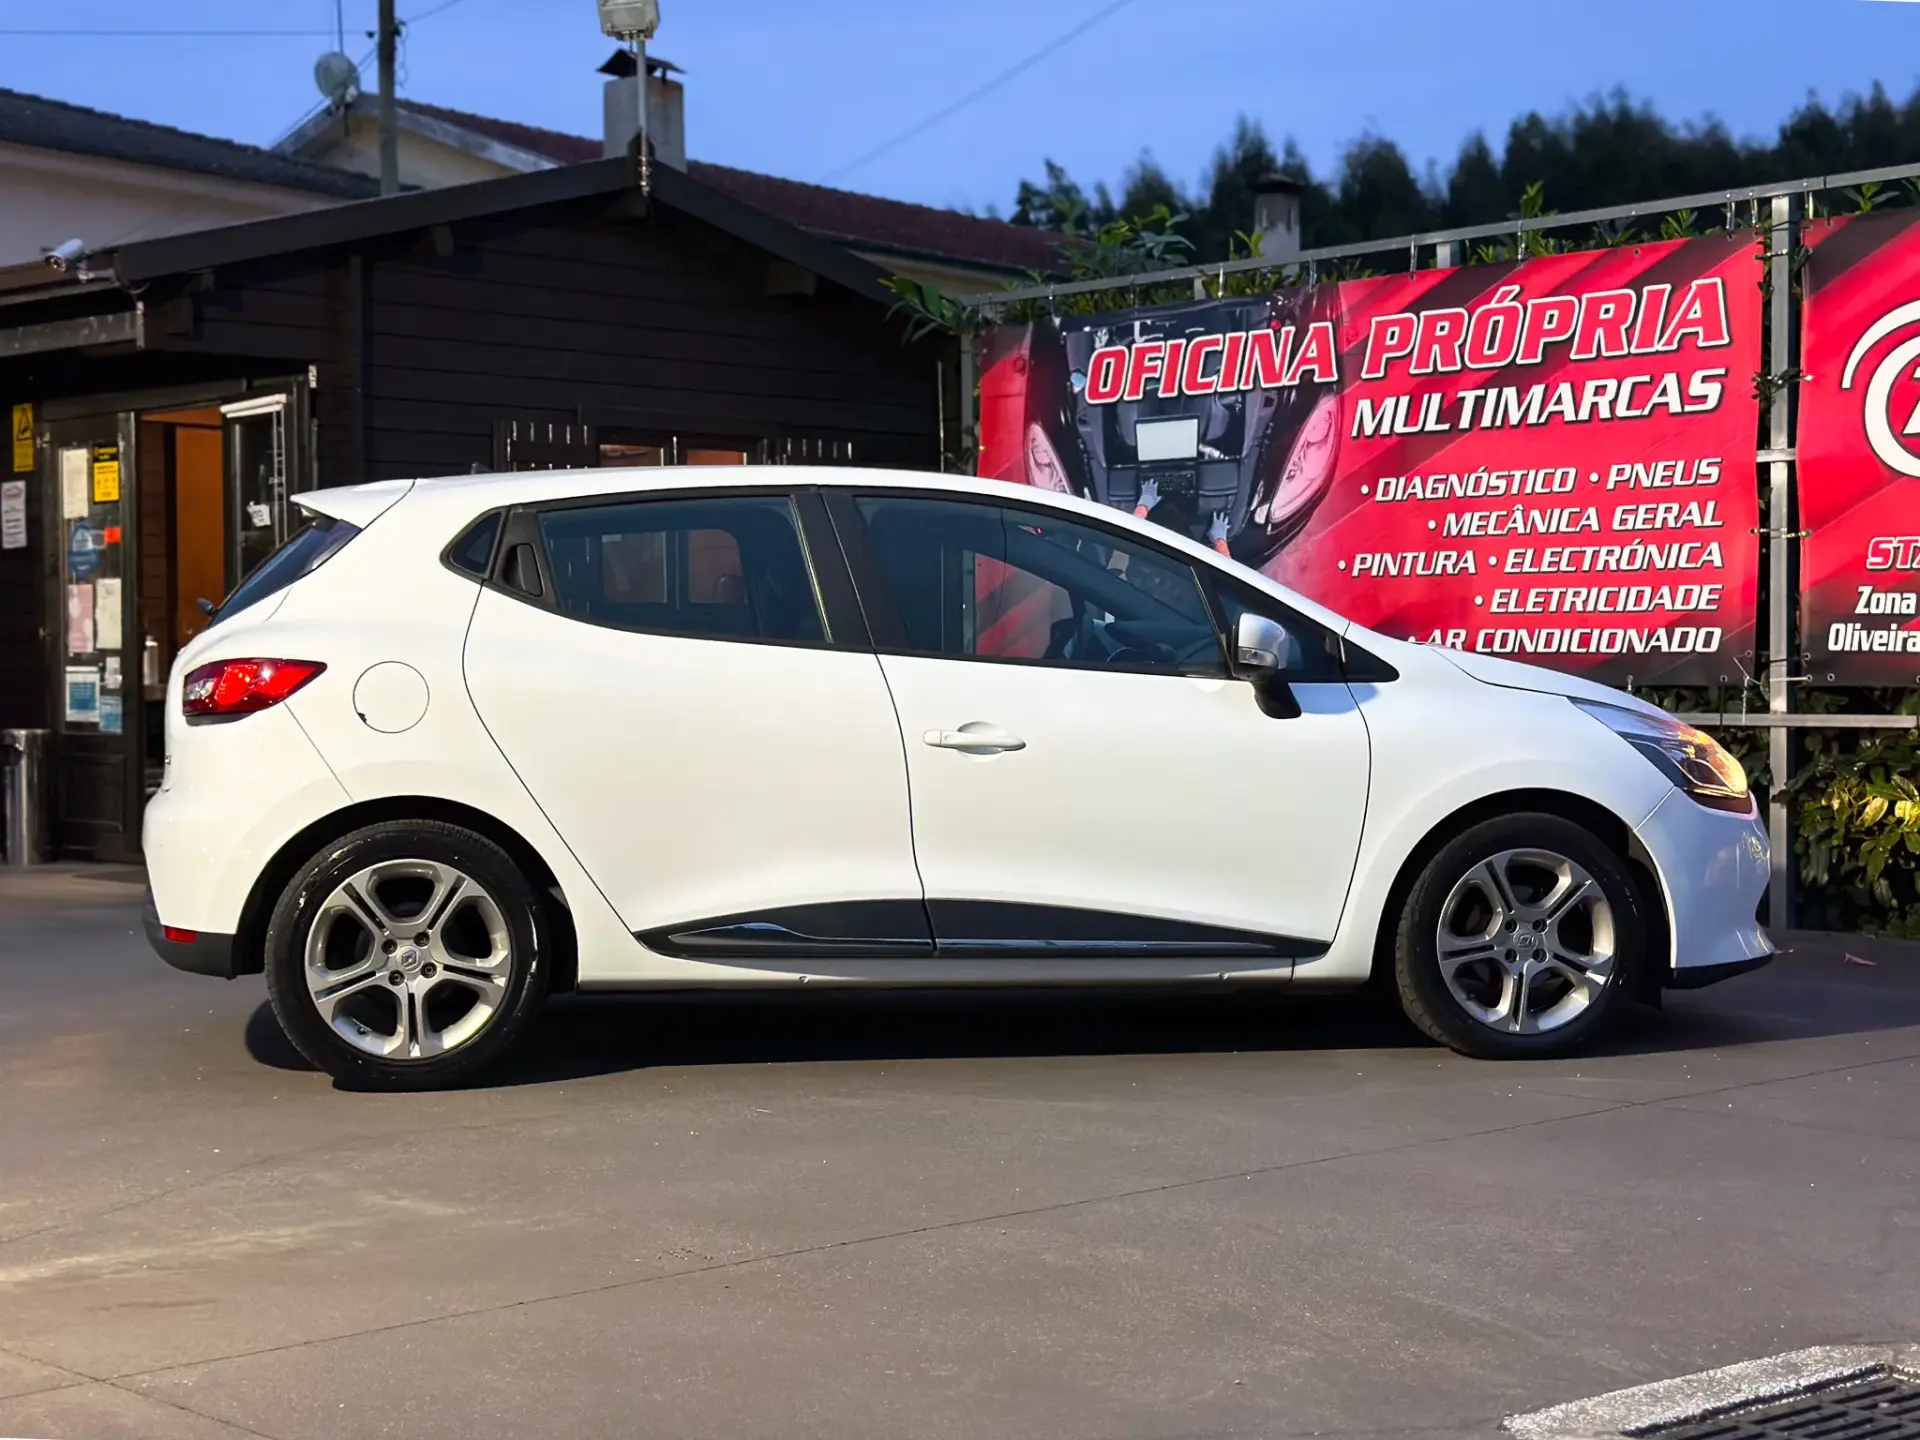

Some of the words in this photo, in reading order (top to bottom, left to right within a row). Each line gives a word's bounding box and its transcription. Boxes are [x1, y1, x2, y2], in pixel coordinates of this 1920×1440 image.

[1085, 321, 1338, 405] OFICINA
[1362, 276, 1731, 379] PRÓPRIA
[1351, 368, 1726, 438] MULTIMARCAS
[1375, 465, 1577, 501] DIAGNÓSTICO
[1606, 457, 1722, 489] PNEUS
[1443, 503, 1600, 537] MECÂNICA
[1612, 500, 1723, 531] GERAL
[1351, 549, 1476, 577] PINTURA
[1504, 538, 1723, 573] ELECTRÓNICA
[1490, 584, 1723, 613] ELETRICIDADE
[1854, 585, 1917, 615] Zona
[1427, 628, 1467, 651] AR
[1475, 627, 1722, 653] CONDICIONADO
[1827, 622, 1920, 653] Oliveira
